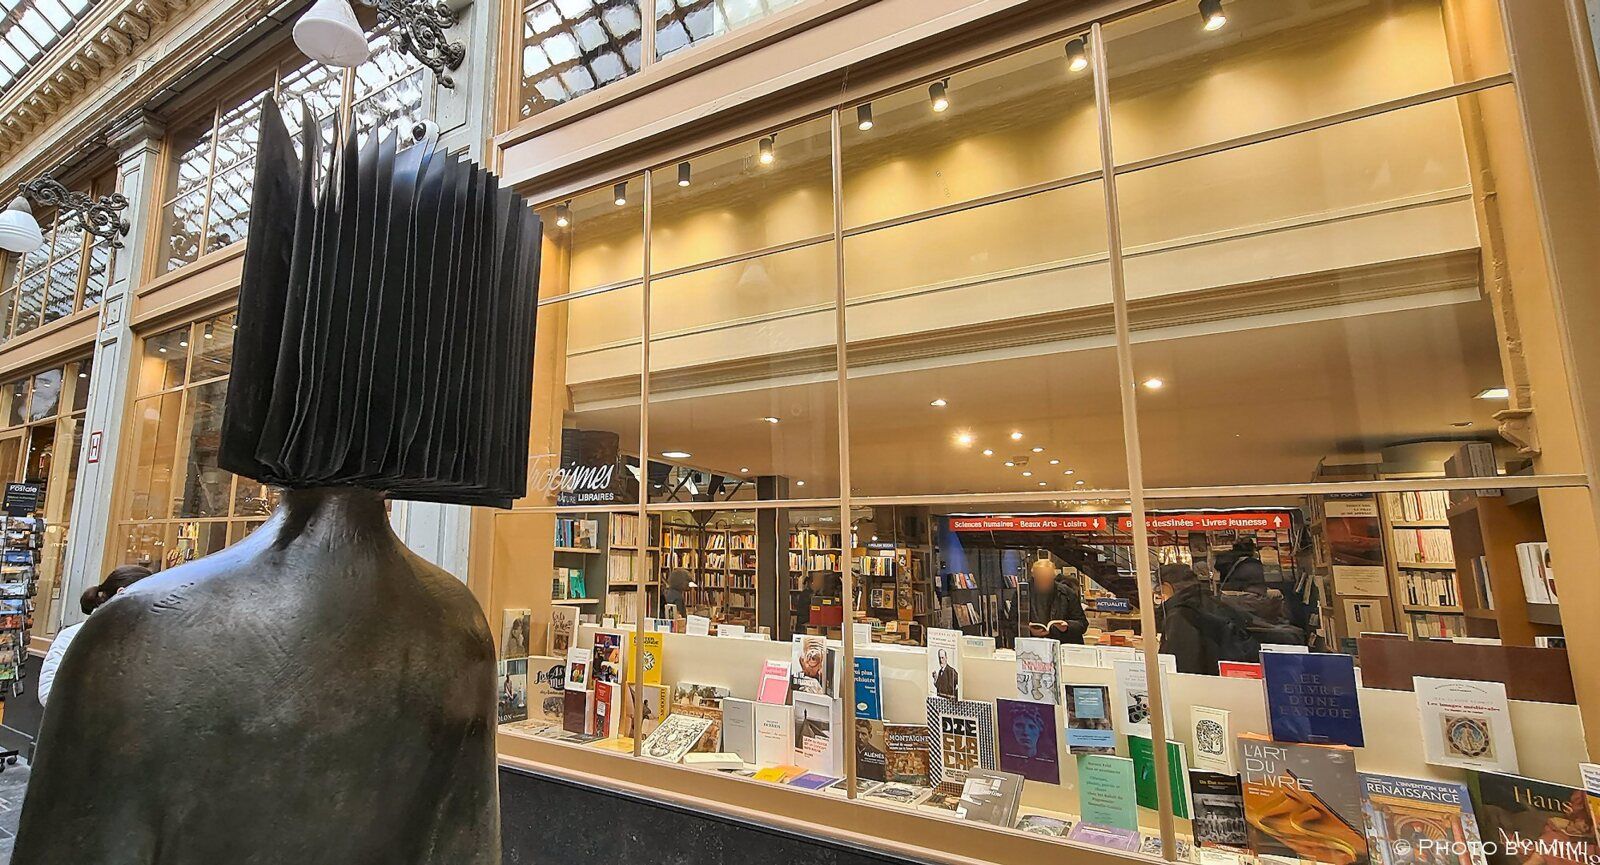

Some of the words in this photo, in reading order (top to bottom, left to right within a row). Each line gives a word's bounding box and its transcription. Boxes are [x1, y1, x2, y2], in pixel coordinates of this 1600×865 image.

[90, 437, 99, 457] H
[577, 492, 614, 502] LIBRAIRES
[983, 520, 1014, 528] humaines
[1020, 520, 1041, 528] Beaux
[1042, 520, 1057, 528] Arts
[1063, 520, 1087, 528] Loisirs
[1152, 519, 1194, 528] dessinées
[1202, 518, 1227, 527] Livres
[1228, 518, 1268, 527] jeunesse
[1244, 744, 1288, 761] L'ART
[1245, 758, 1275, 774] DU
[1247, 771, 1315, 793] LIVRE
[1395, 781, 1437, 792] L'INVENTION
[1366, 782, 1461, 804] RENAISSANCE
[1513, 785, 1574, 815] Hans
